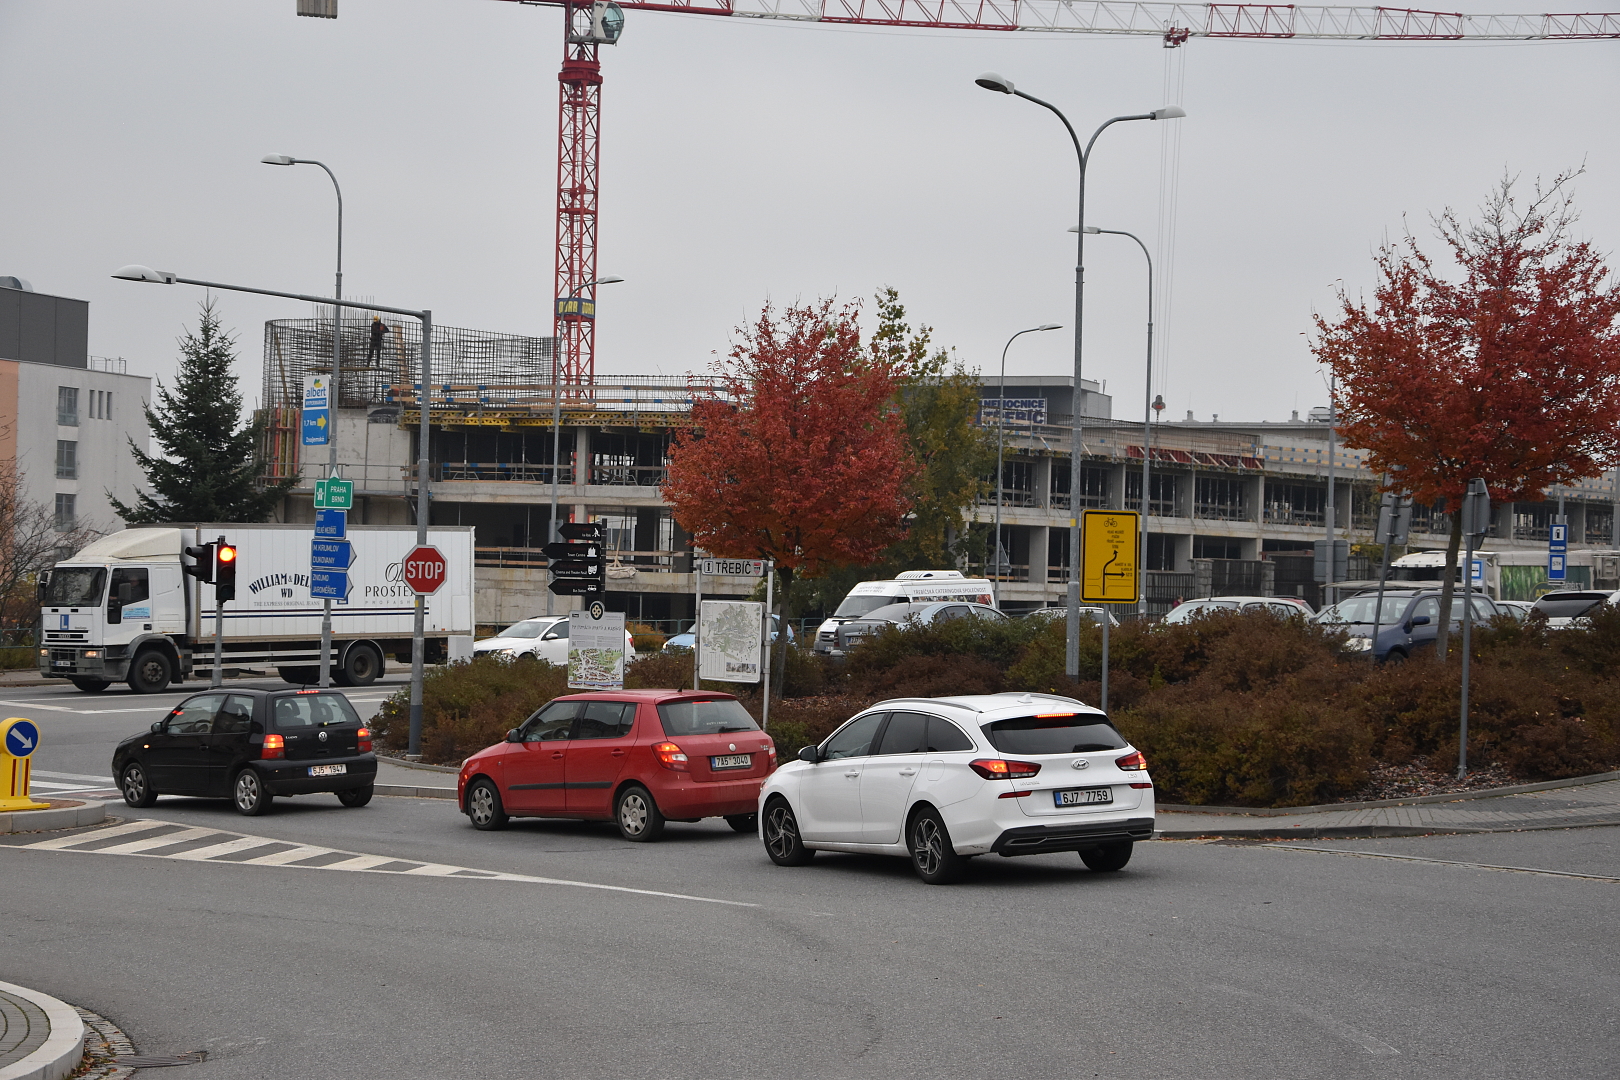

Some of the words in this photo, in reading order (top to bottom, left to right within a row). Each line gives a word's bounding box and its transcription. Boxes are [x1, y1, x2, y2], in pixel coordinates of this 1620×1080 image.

[306, 386, 326, 398] albert
[312, 556, 335, 564] DUKOVANY
[407, 561, 443, 579] STOP
[716, 560, 751, 574] TŘEBÍČ
[248, 573, 287, 594] WILLIAM
[294, 574, 310, 588] DEL
[281, 588, 293, 598] WD
[365, 586, 414, 597] PROSTE
[733, 756, 748, 765] 3040
[1063, 792, 1079, 803] 6J7
[1086, 790, 1108, 801] 7759
